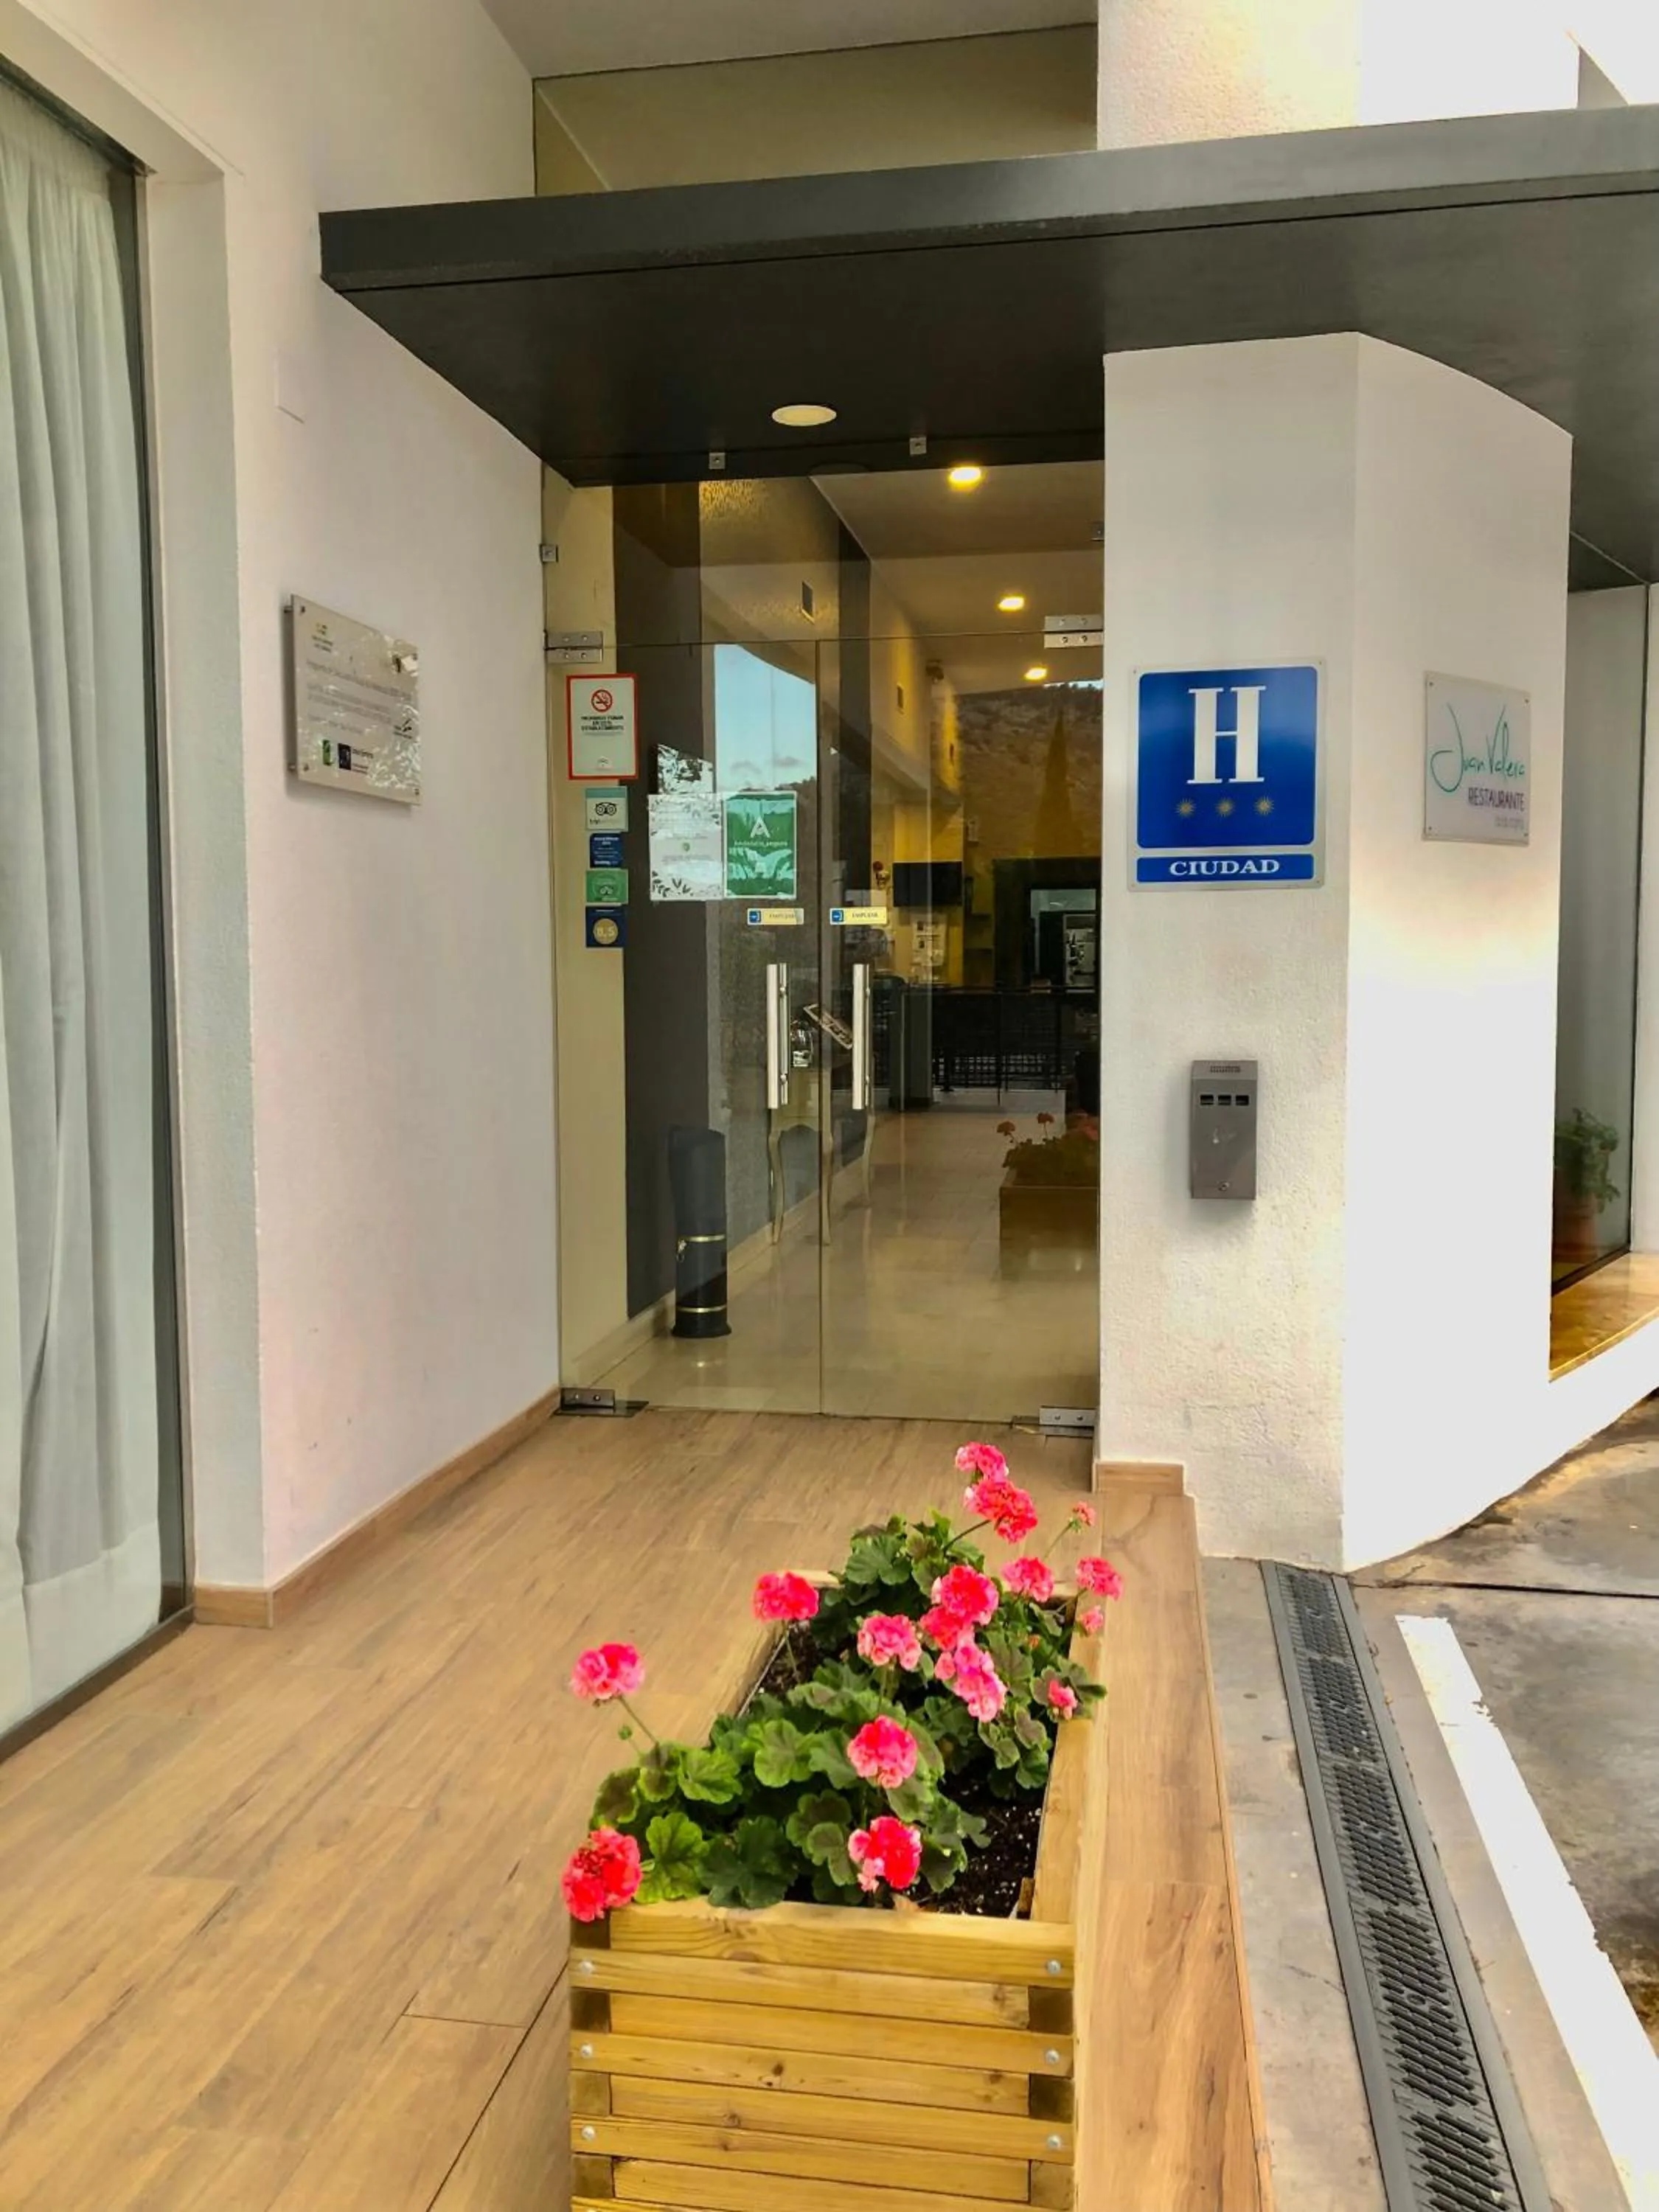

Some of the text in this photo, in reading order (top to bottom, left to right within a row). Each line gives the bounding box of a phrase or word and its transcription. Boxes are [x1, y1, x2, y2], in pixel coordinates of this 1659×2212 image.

[1187, 686, 1266, 784] H
[1430, 701, 1486, 793] Juan
[1468, 787, 1525, 812] RESTAURANTE
[1169, 859, 1280, 876] CIUDAD
